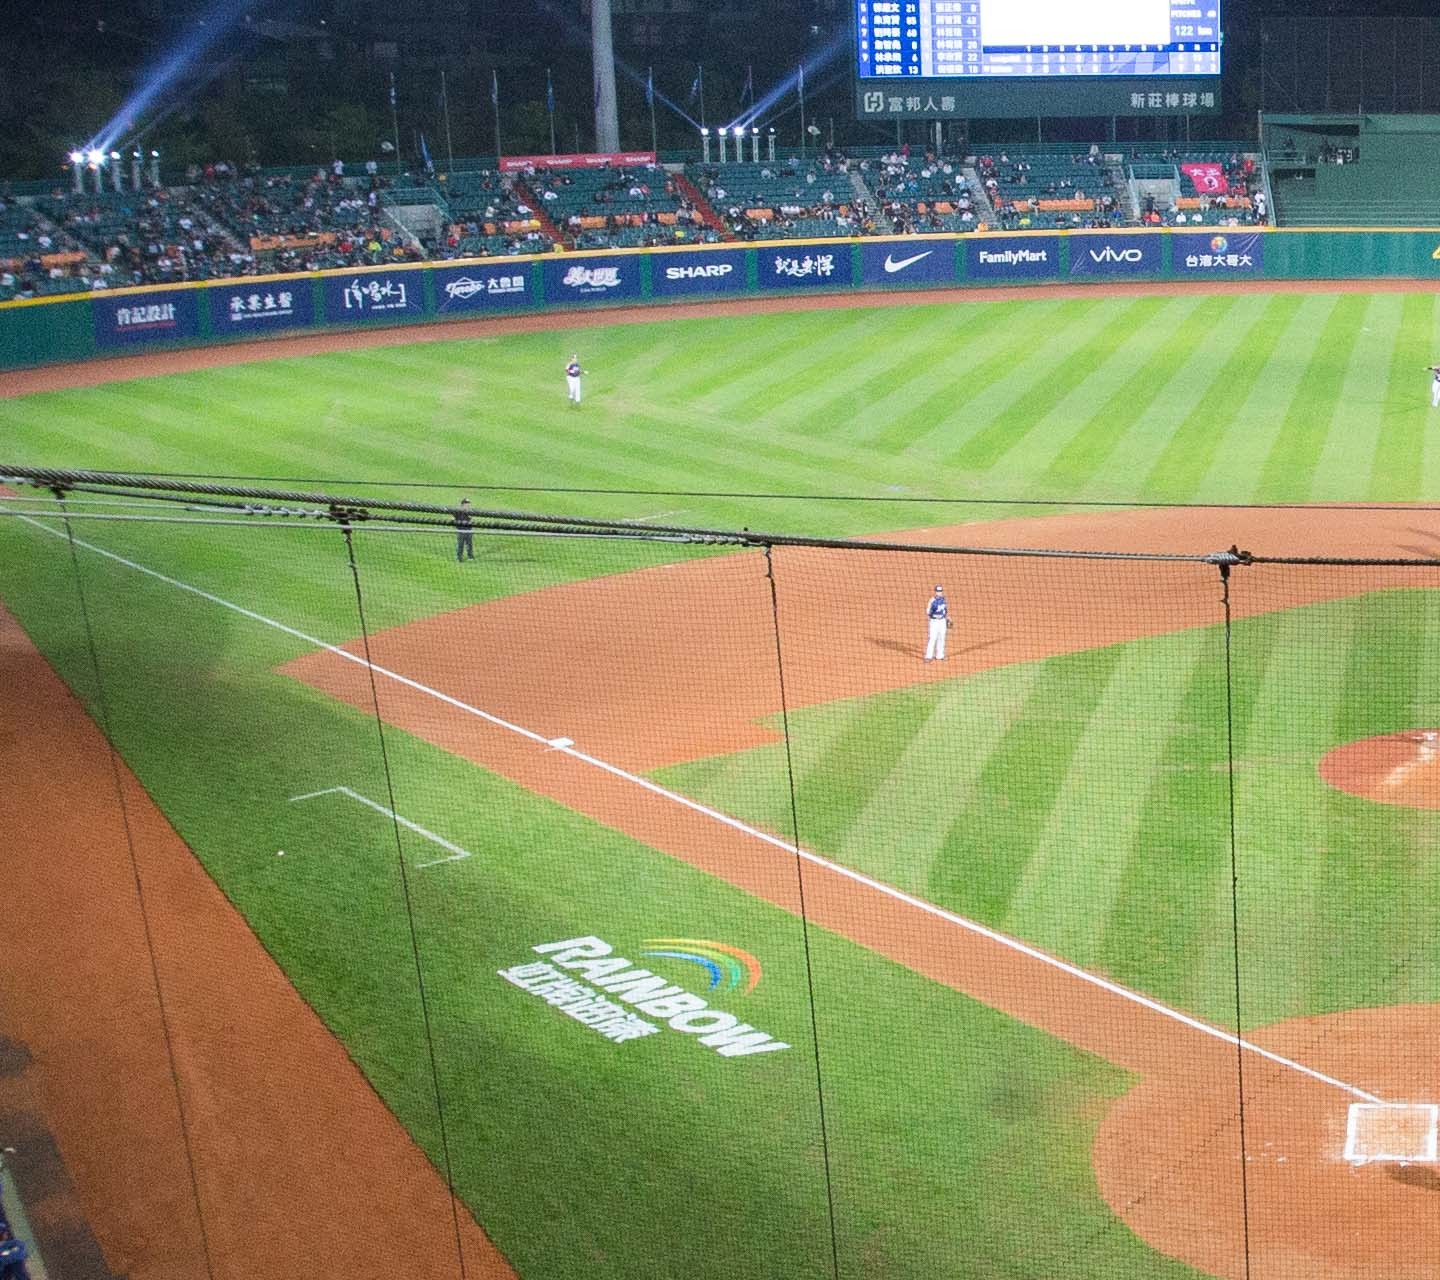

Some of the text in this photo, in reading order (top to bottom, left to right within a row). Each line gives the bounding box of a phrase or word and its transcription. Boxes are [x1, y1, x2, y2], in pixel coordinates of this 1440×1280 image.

[1174, 25, 1193, 36] 122
[888, 96, 956, 112] 富邦人壽
[1130, 93, 1215, 109] 新莊棒球場
[979, 249, 1047, 265] FamilyMart
[1089, 246, 1142, 263] vivo
[666, 264, 732, 280] SHARP
[532, 935, 791, 1057] RAINBOW
